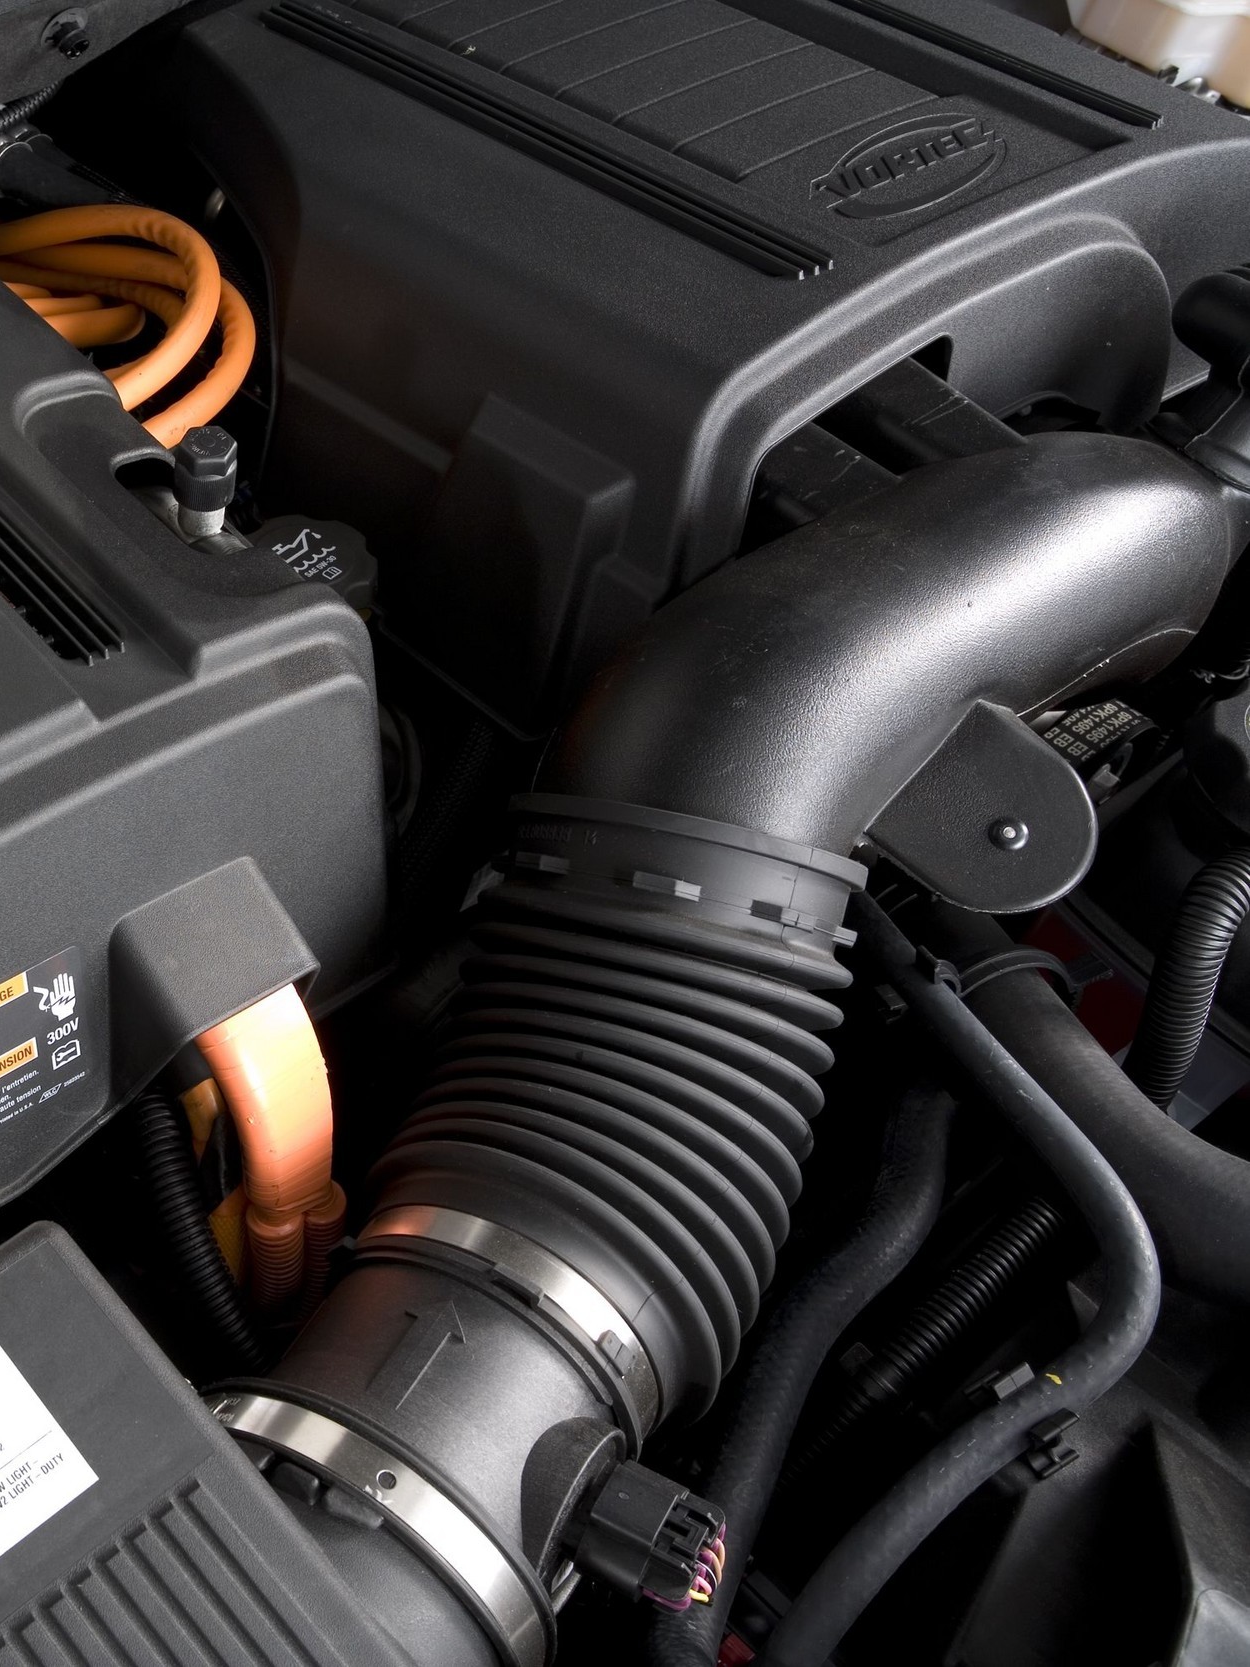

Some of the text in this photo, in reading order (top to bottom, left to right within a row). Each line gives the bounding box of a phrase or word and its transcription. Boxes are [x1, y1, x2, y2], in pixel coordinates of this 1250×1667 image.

[811, 118, 996, 208] VORTEC
[304, 555, 337, 578] SAE 5W-30
[46, 1016, 79, 1045] 300V
